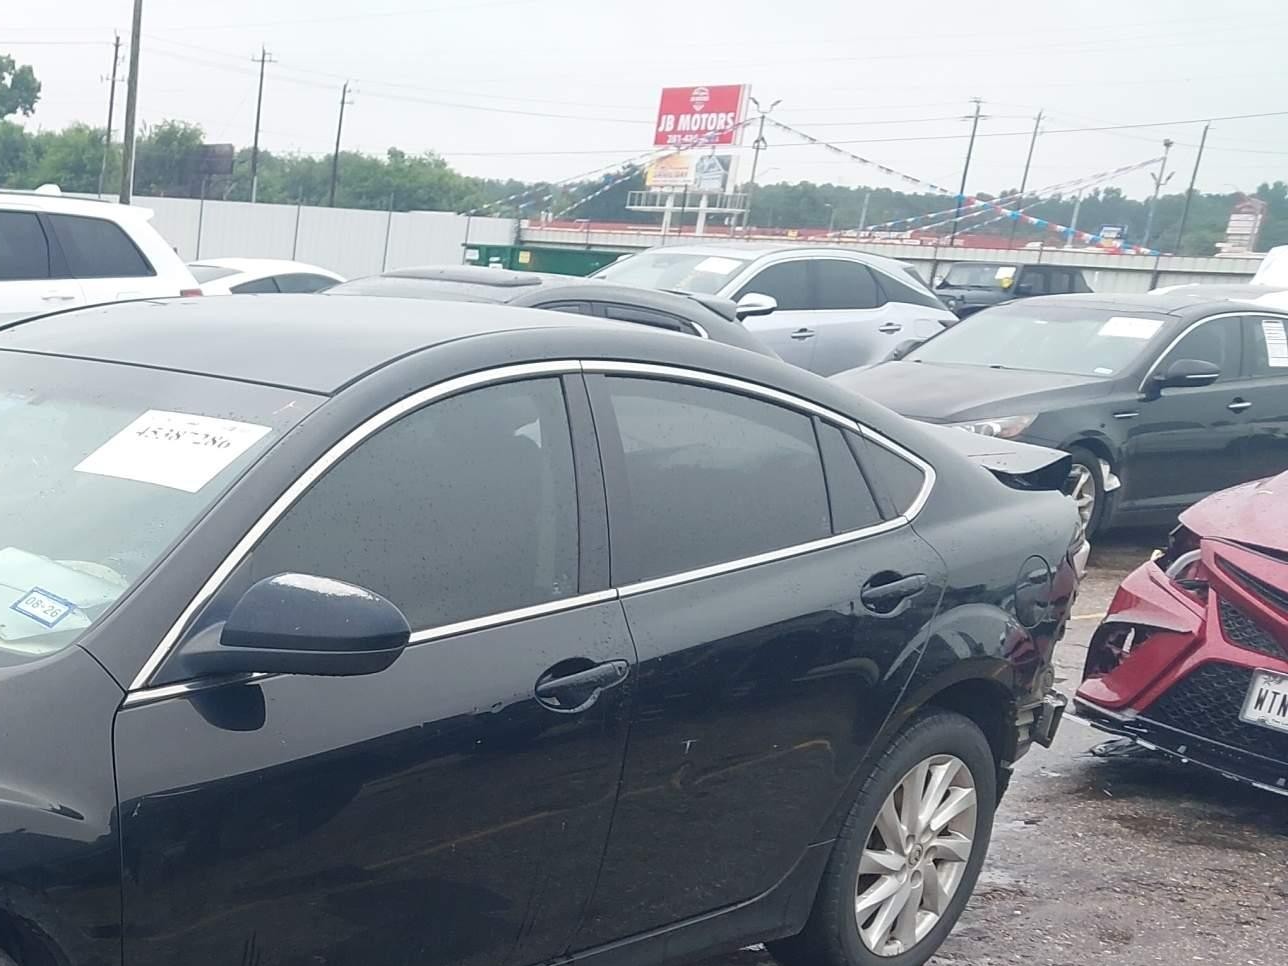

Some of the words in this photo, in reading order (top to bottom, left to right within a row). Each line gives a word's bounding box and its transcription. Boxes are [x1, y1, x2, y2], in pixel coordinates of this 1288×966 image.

[658, 114, 675, 132] JB
[677, 112, 736, 131] MOTORS
[24, 597, 62, 618] 08-26
